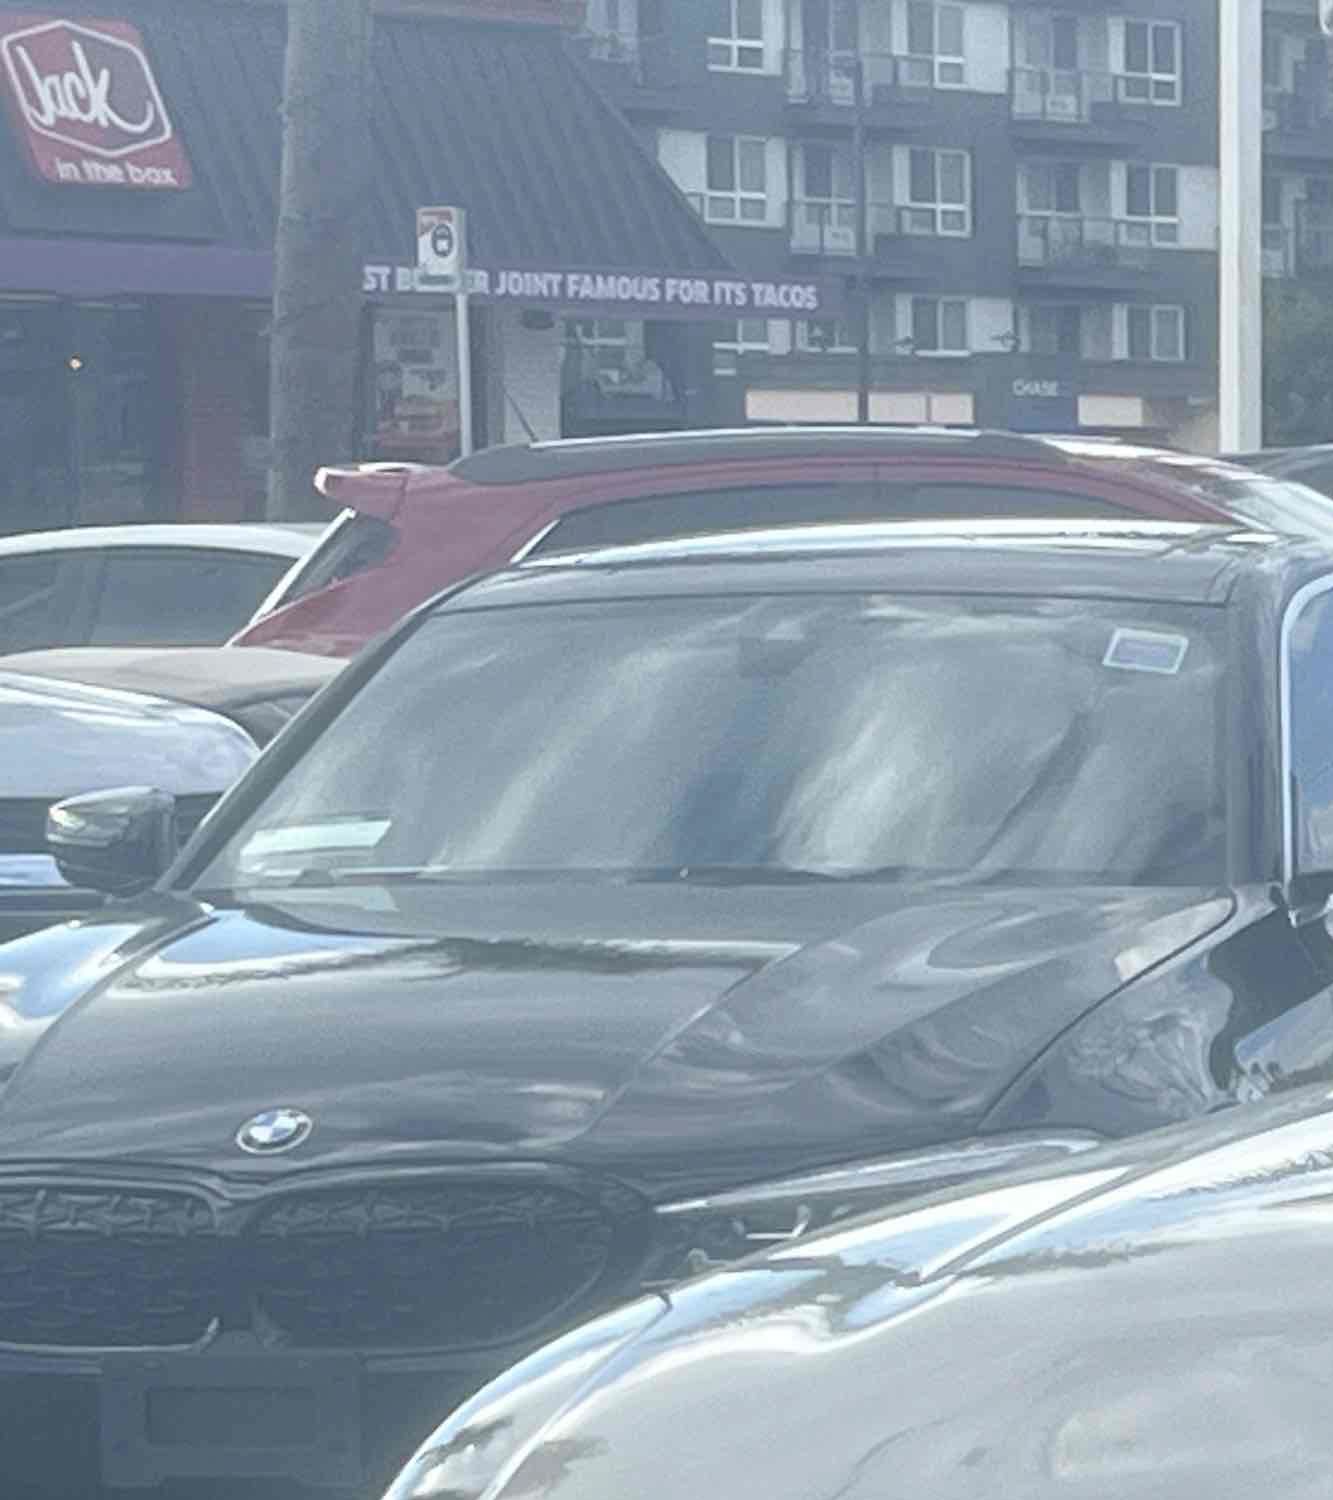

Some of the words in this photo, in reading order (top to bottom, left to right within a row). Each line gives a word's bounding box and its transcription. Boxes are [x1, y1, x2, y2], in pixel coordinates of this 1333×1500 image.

[15, 40, 154, 133] Jack
[495, 270, 562, 297] JOINT
[566, 273, 661, 302] FAMOUS
[664, 277, 710, 305] FOR
[712, 280, 748, 307] ITS
[751, 282, 818, 311] TACOS
